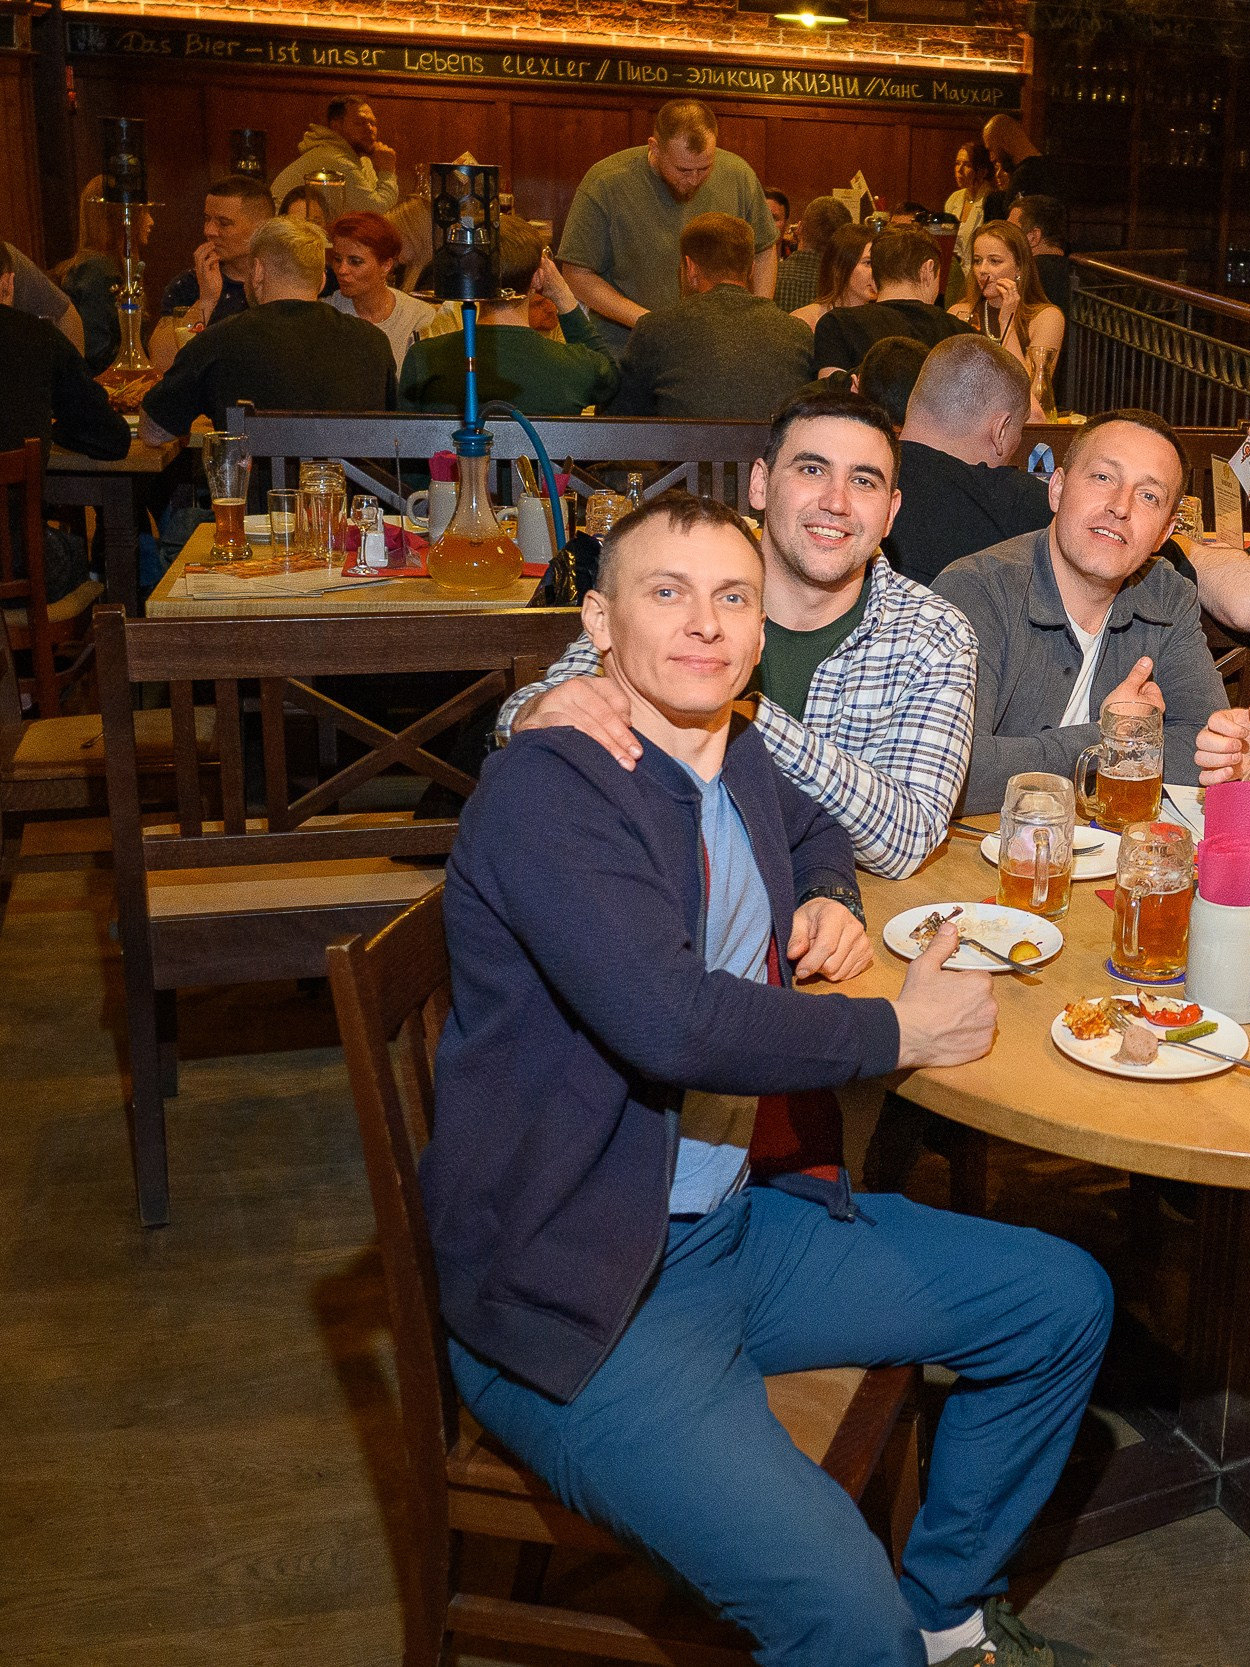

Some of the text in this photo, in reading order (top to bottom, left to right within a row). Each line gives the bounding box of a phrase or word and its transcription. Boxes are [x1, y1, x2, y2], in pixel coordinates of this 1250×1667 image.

[117, 31, 171, 54] Das
[184, 33, 240, 55] Bier
[268, 41, 300, 63] ist
[312, 47, 385, 67] unser
[404, 49, 484, 74] Lebens
[618, 61, 668, 82] Пиво
[878, 77, 923, 99] Ханс
[932, 80, 1004, 106] Маухар
